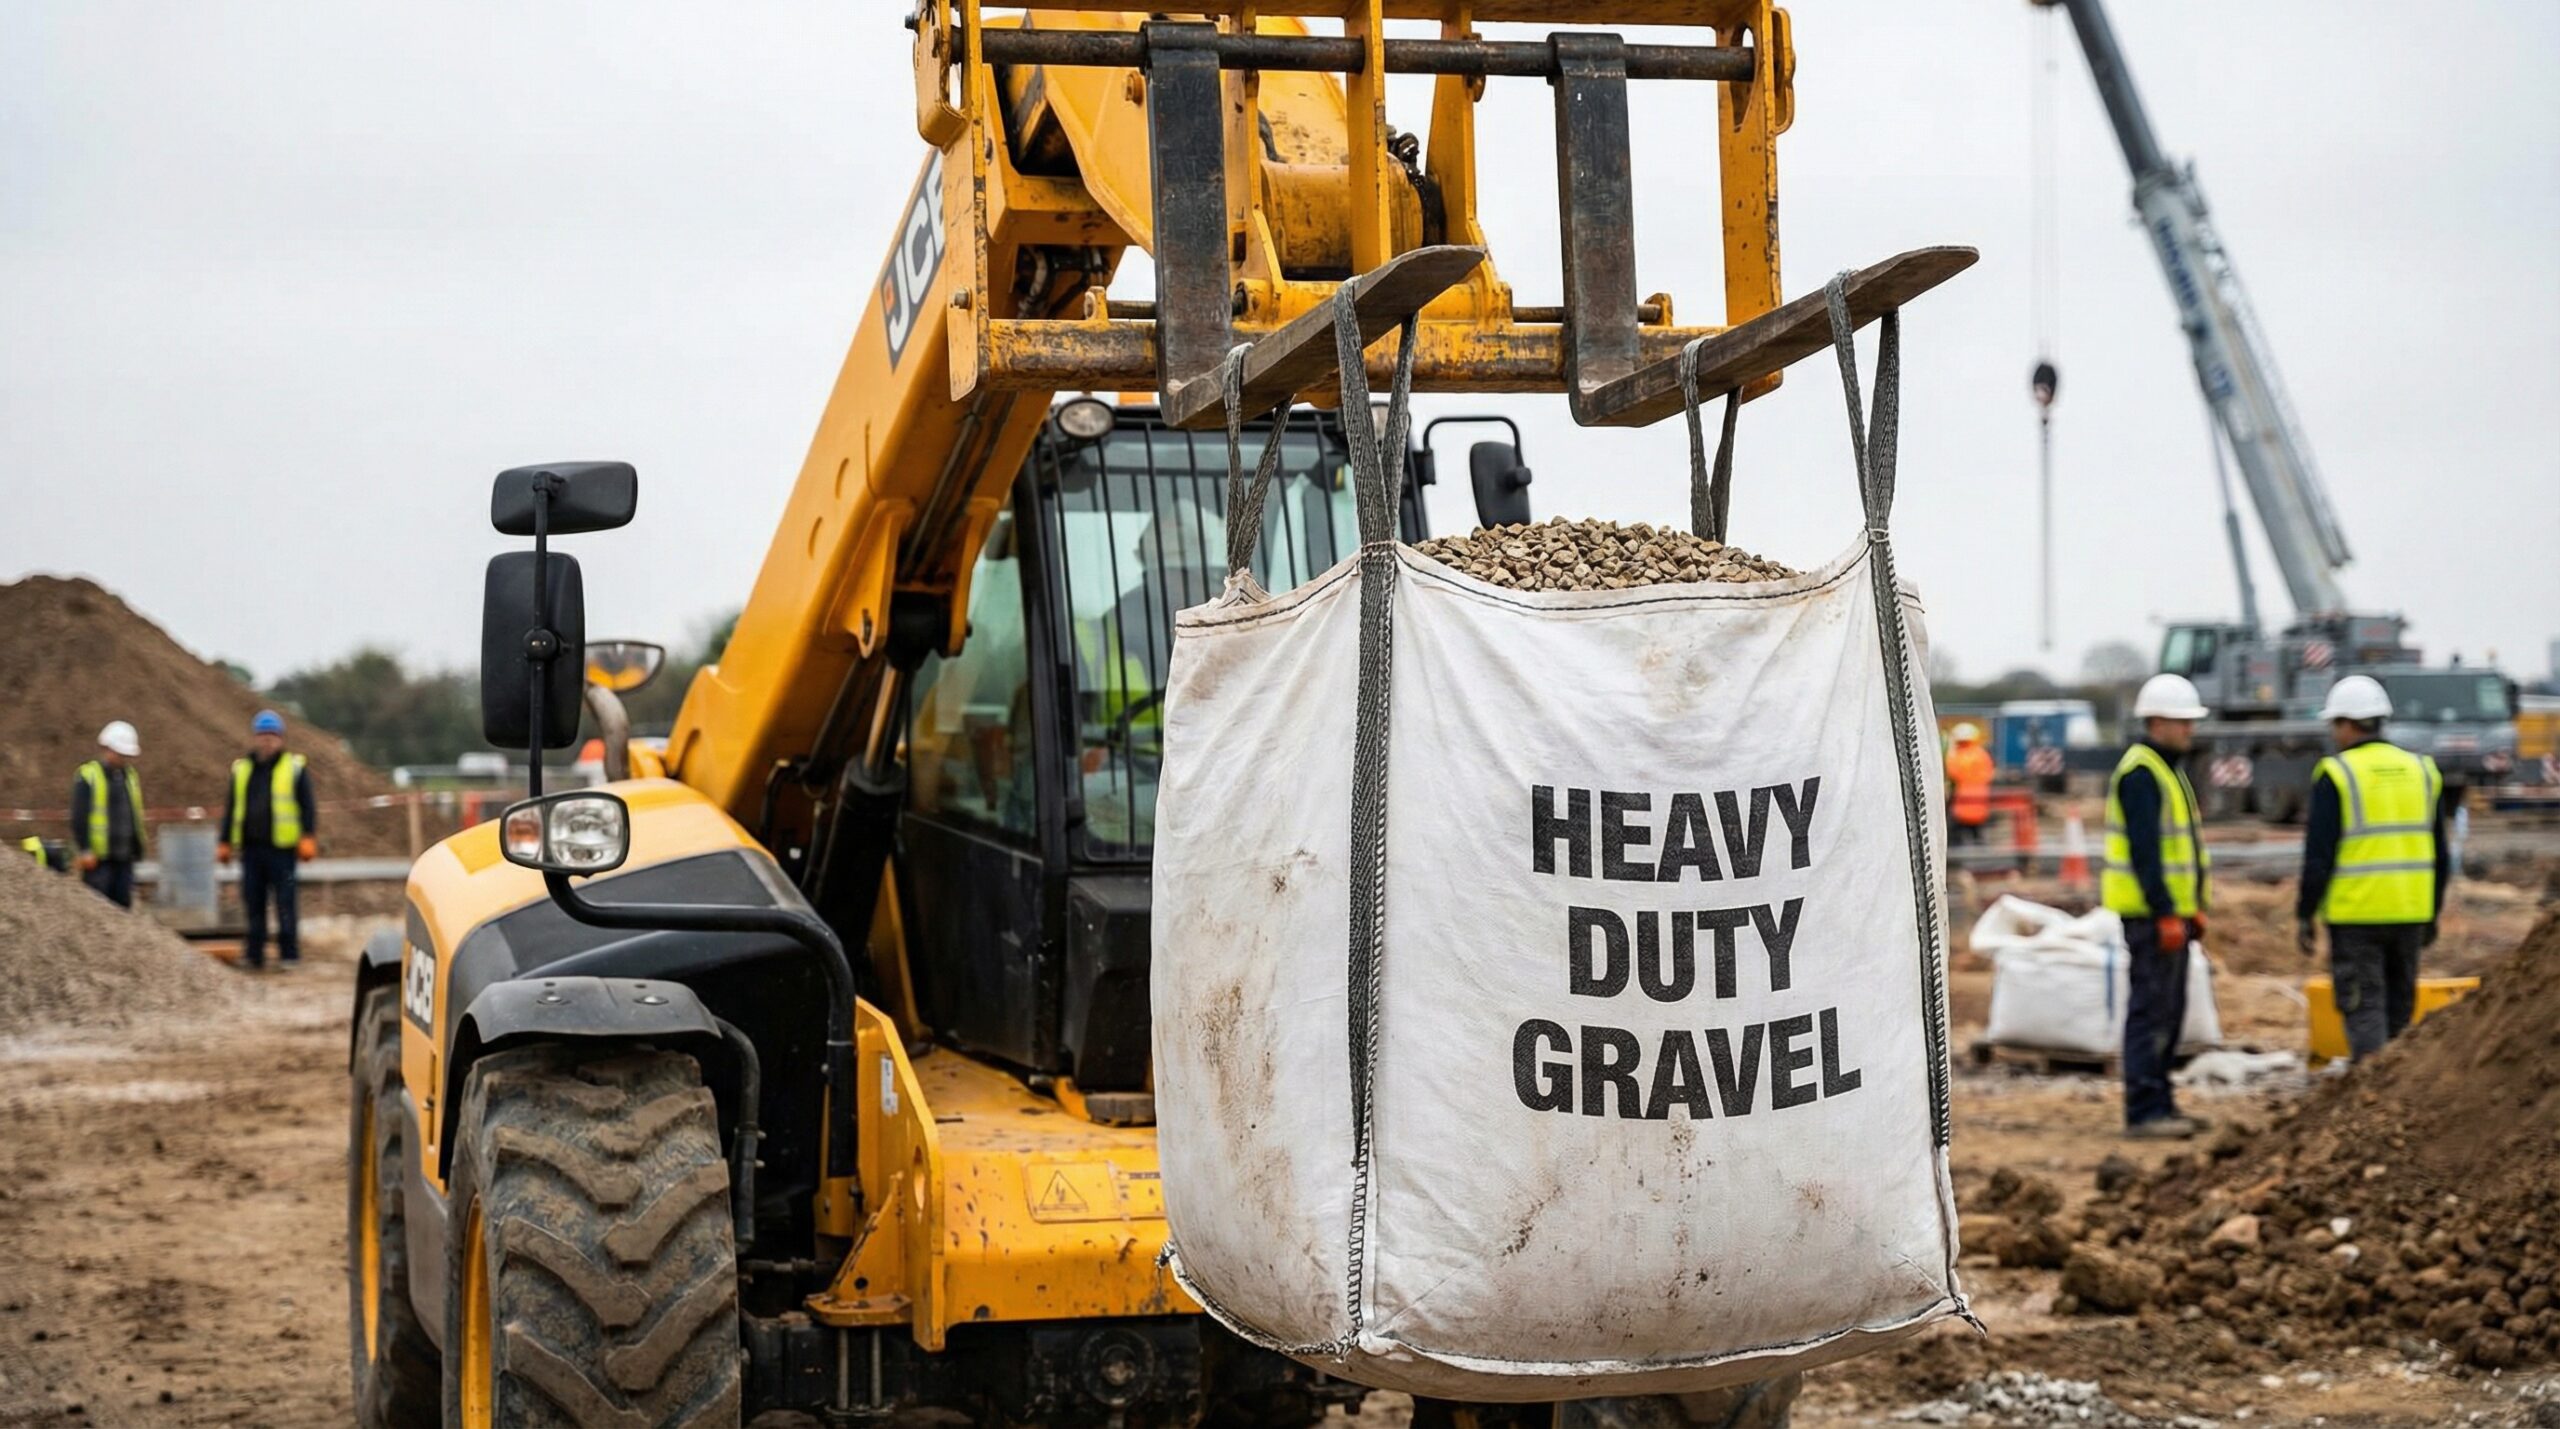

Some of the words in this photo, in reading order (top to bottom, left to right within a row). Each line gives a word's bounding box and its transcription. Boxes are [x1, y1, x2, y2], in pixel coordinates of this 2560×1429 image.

[1531, 776, 1821, 882] HEAVY
[405, 945, 436, 1024] JCB
[1568, 897, 1805, 1002] DUTY
[1512, 1006, 1862, 1120] GRAVEL
